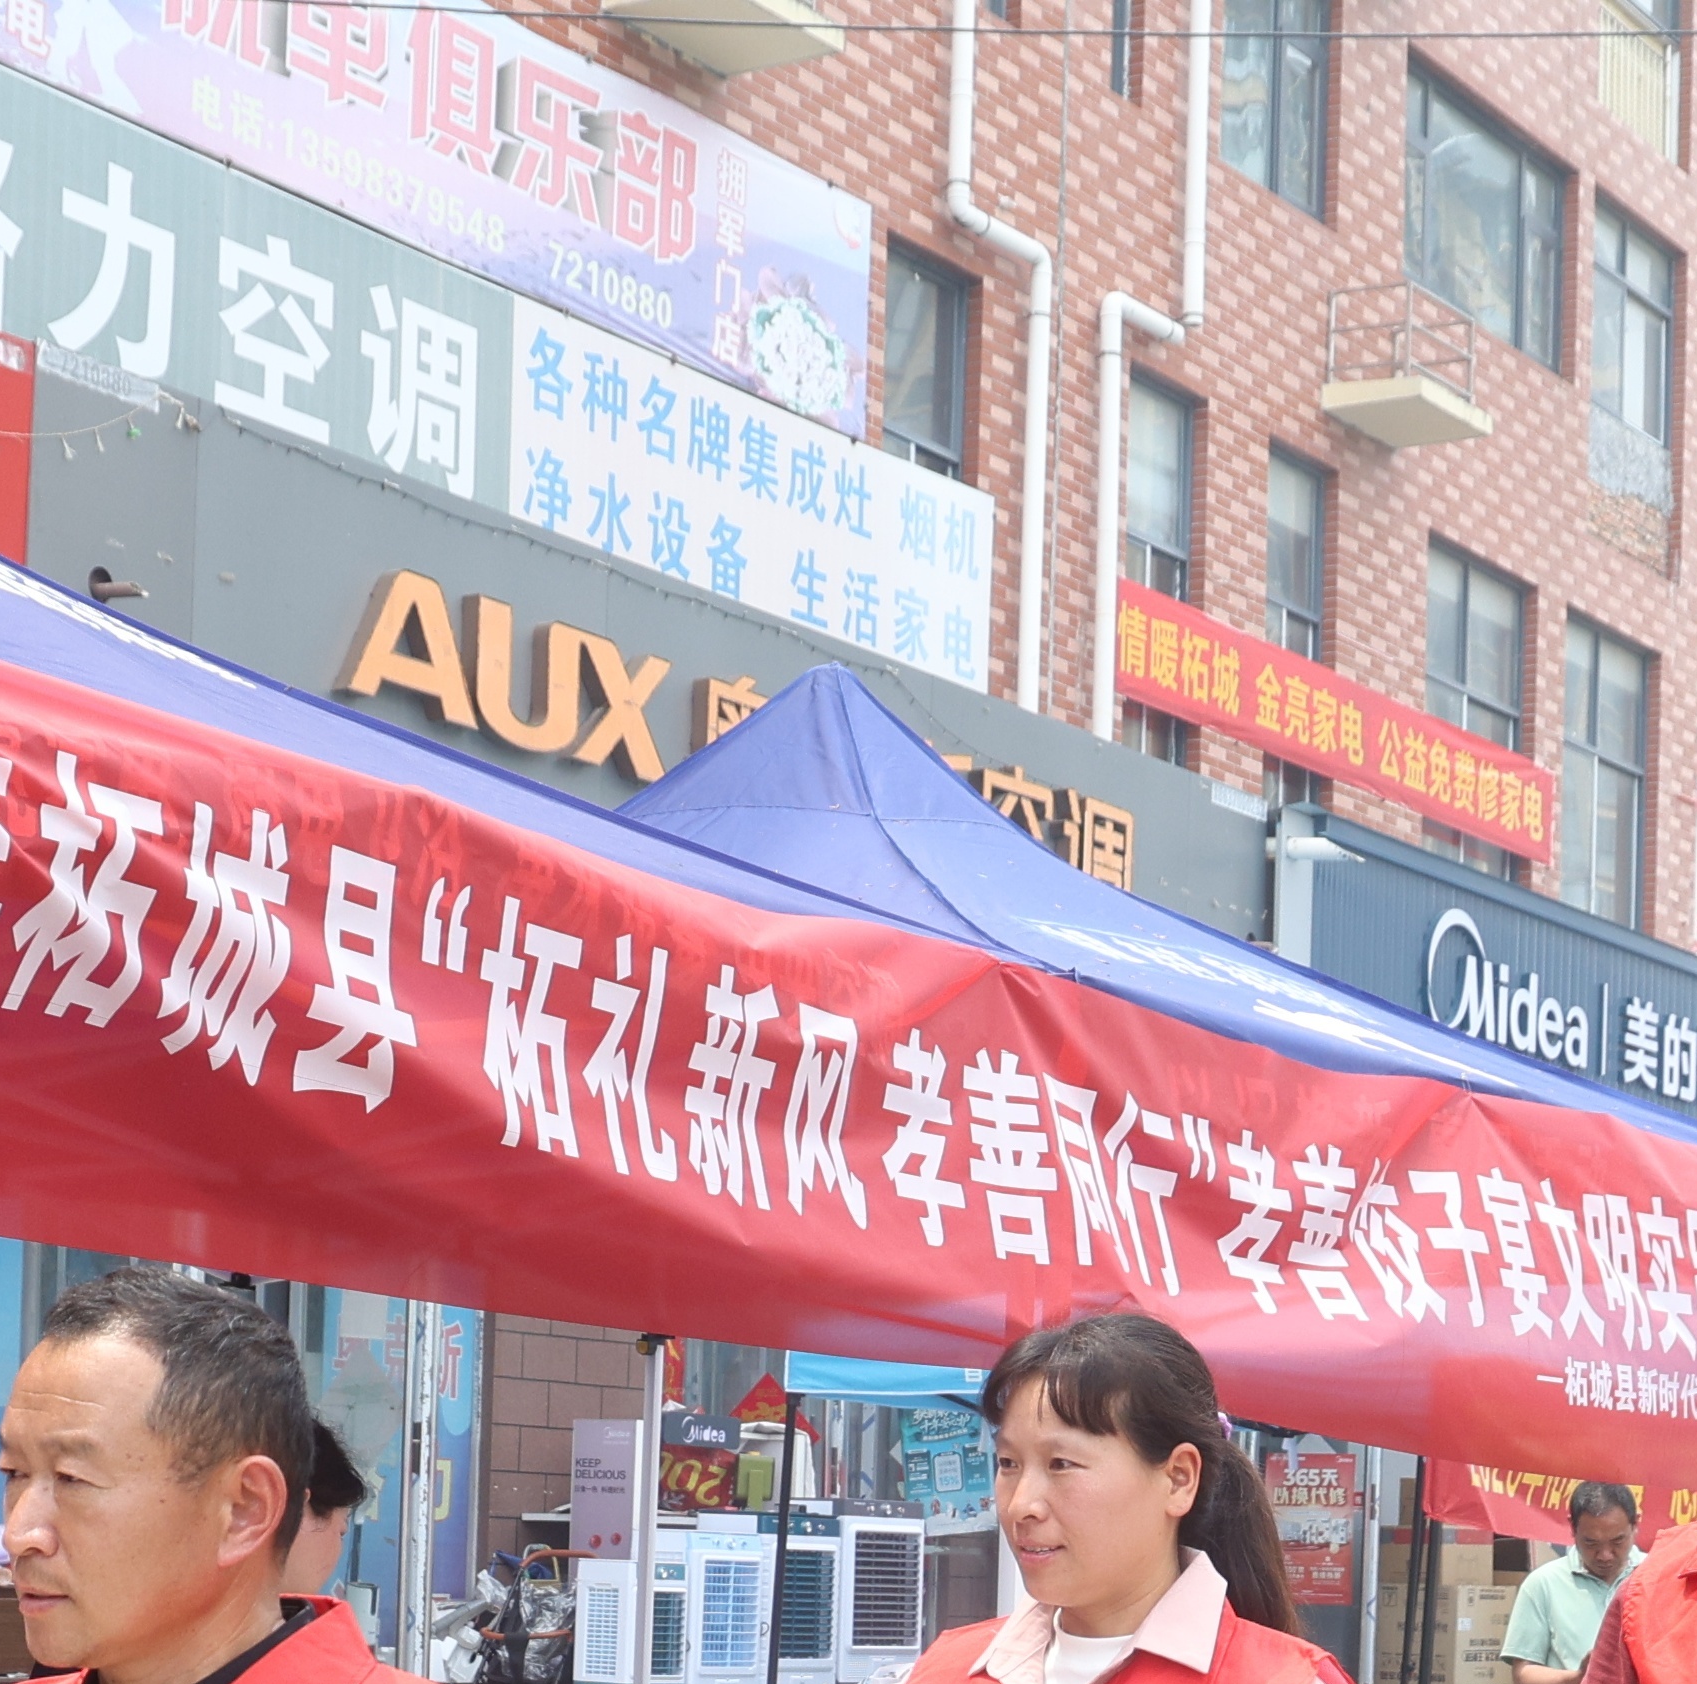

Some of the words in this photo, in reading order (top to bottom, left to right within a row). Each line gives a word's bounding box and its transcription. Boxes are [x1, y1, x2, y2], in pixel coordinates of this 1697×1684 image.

[549, 239, 673, 330] 7210880
[713, 145, 749, 369] 拥军门店
[526, 326, 873, 541] 各种名牌集成灶
[898, 484, 980, 582] 烟机
[523, 446, 748, 601] 净水设备
[790, 548, 977, 682] 生活家电
[335, 568, 671, 783] AUX
[1255, 663, 1364, 766] 金亮家电
[1377, 718, 1544, 842] 公益免费修家电
[1427, 908, 1589, 1068] Midea
[575, 1457, 601, 1468] KEEP
[575, 1468, 626, 1480] DELICIOUS
[681, 1415, 726, 1444] Midea
[1282, 1468, 1339, 1487] 365天
